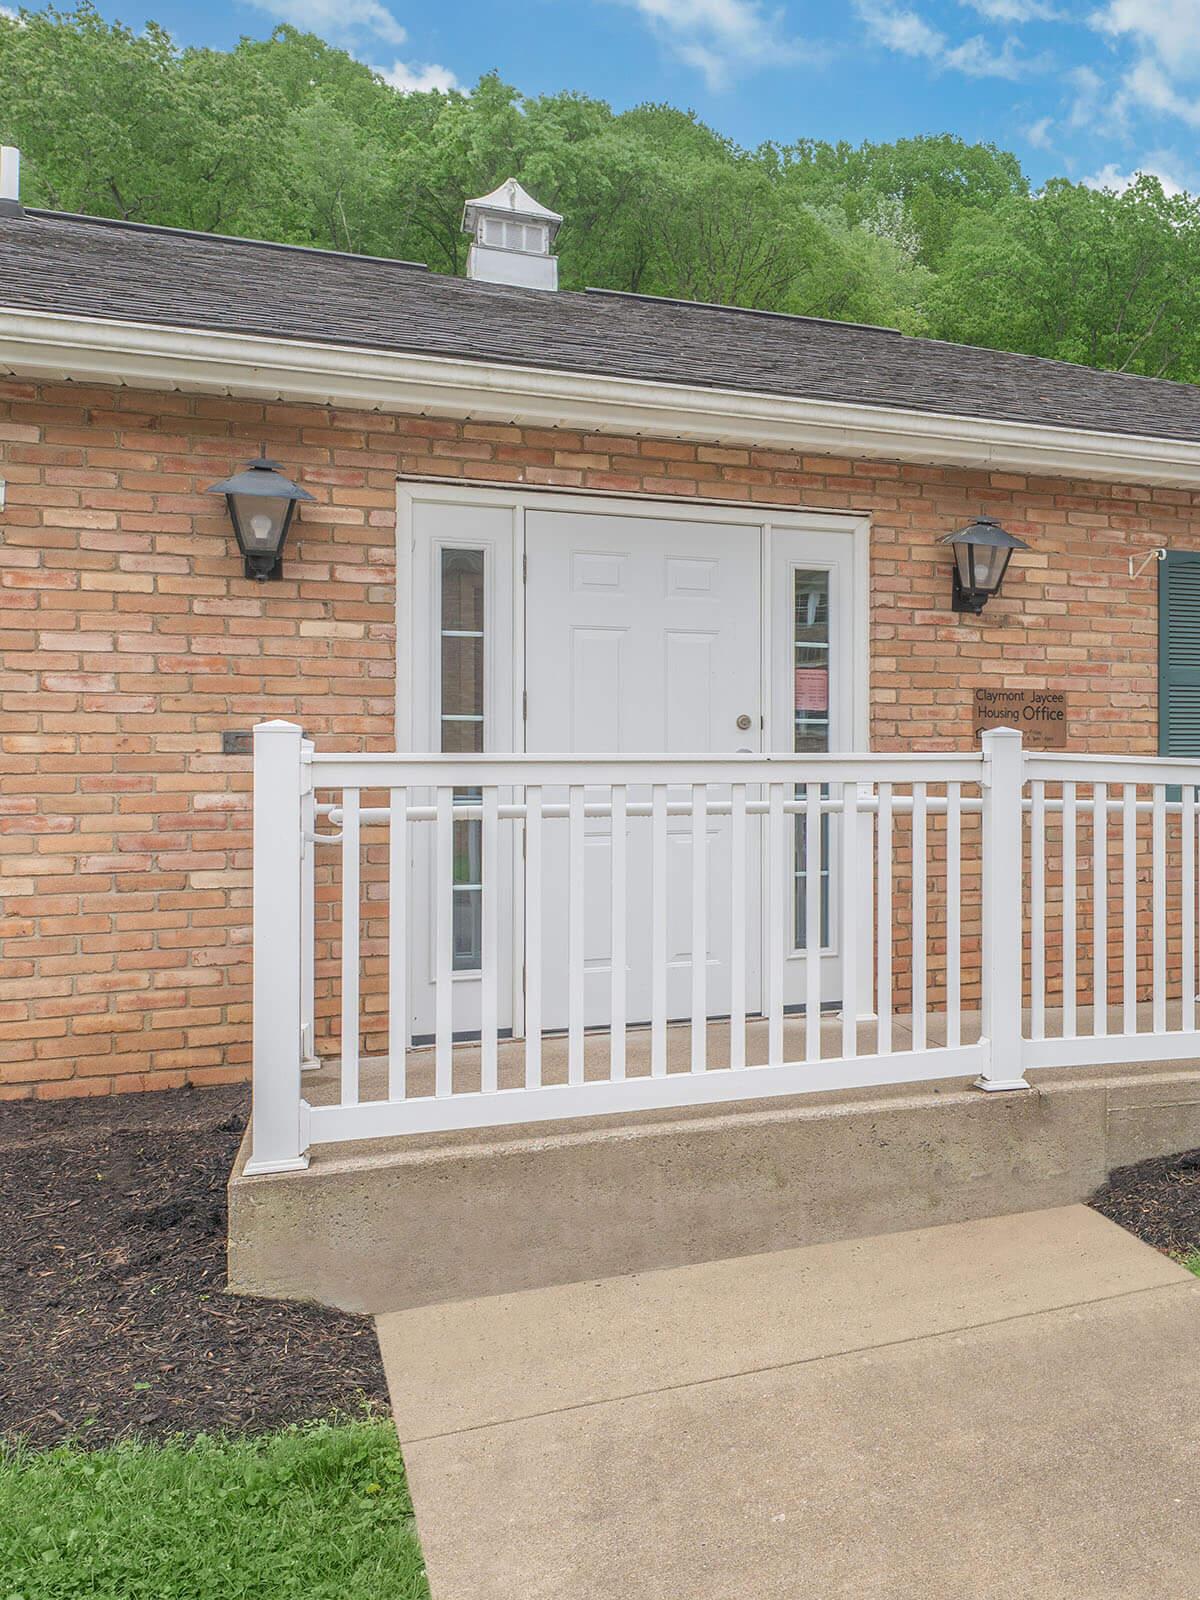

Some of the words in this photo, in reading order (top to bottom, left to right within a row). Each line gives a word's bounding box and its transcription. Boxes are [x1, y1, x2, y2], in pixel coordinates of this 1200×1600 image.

[976, 689, 1025, 704] Claymont
[1030, 691, 1064, 706] Jaycee
[978, 706, 1019, 722] Housing
[1022, 705, 1064, 720] Office
